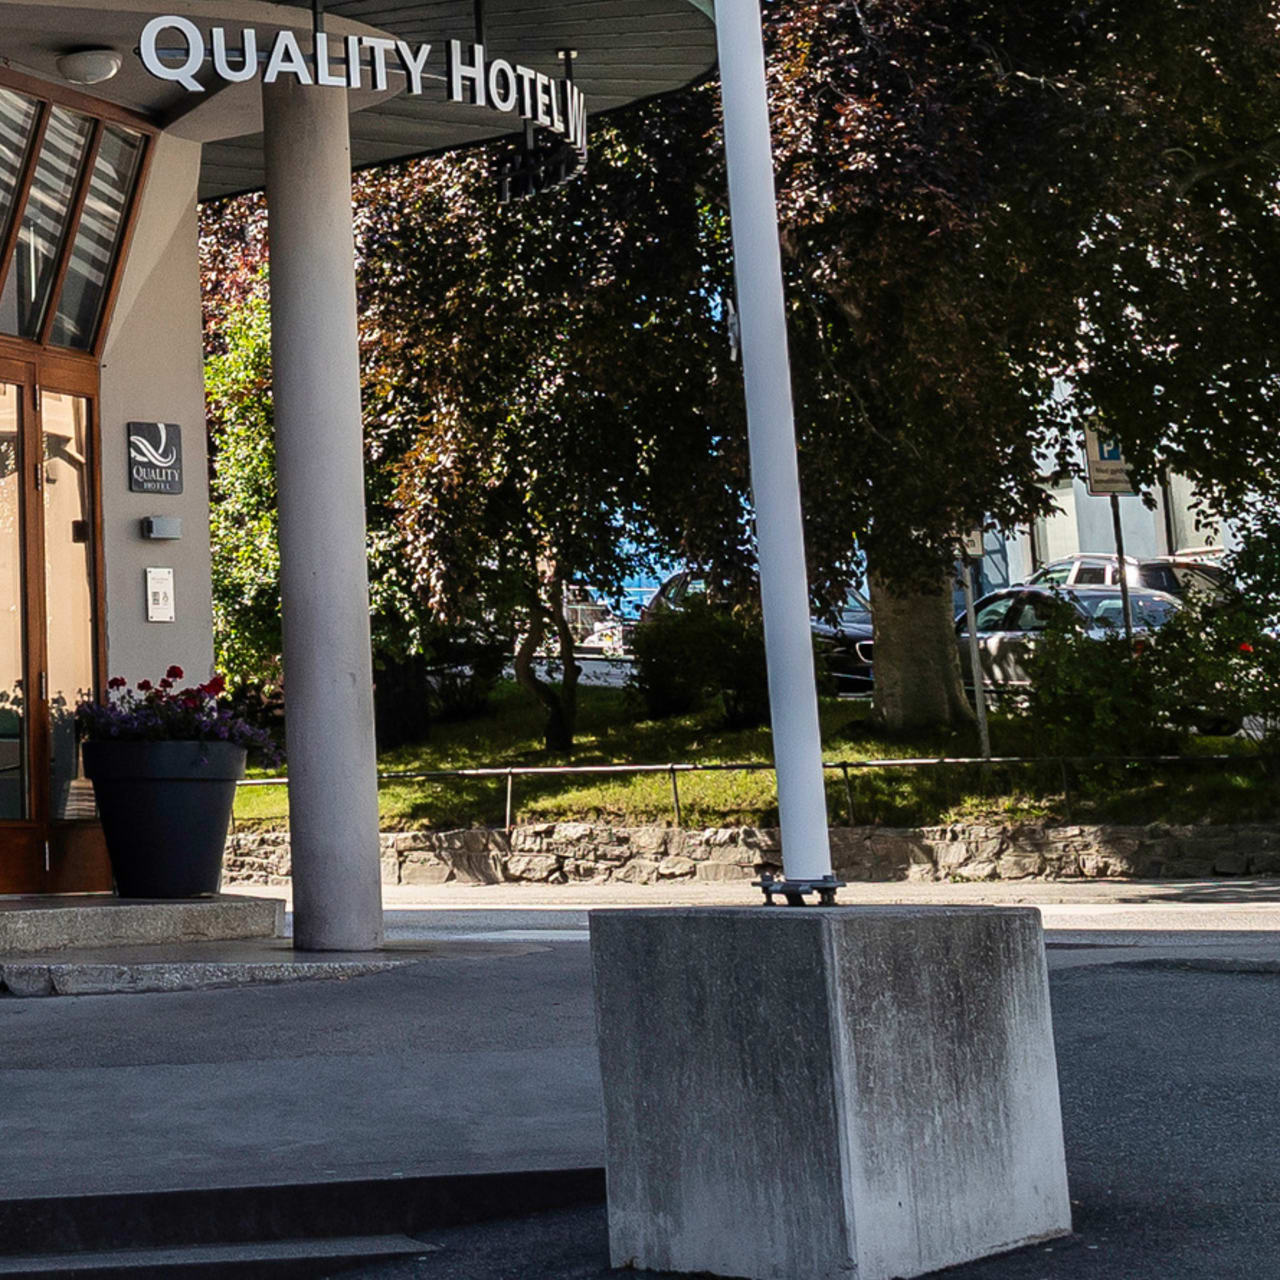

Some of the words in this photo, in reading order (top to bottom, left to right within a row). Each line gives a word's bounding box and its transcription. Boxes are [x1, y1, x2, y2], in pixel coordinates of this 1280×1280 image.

[140, 15, 431, 94] QUALITY
[450, 39, 565, 132] HOTEL
[133, 465, 180, 481] QUALITY
